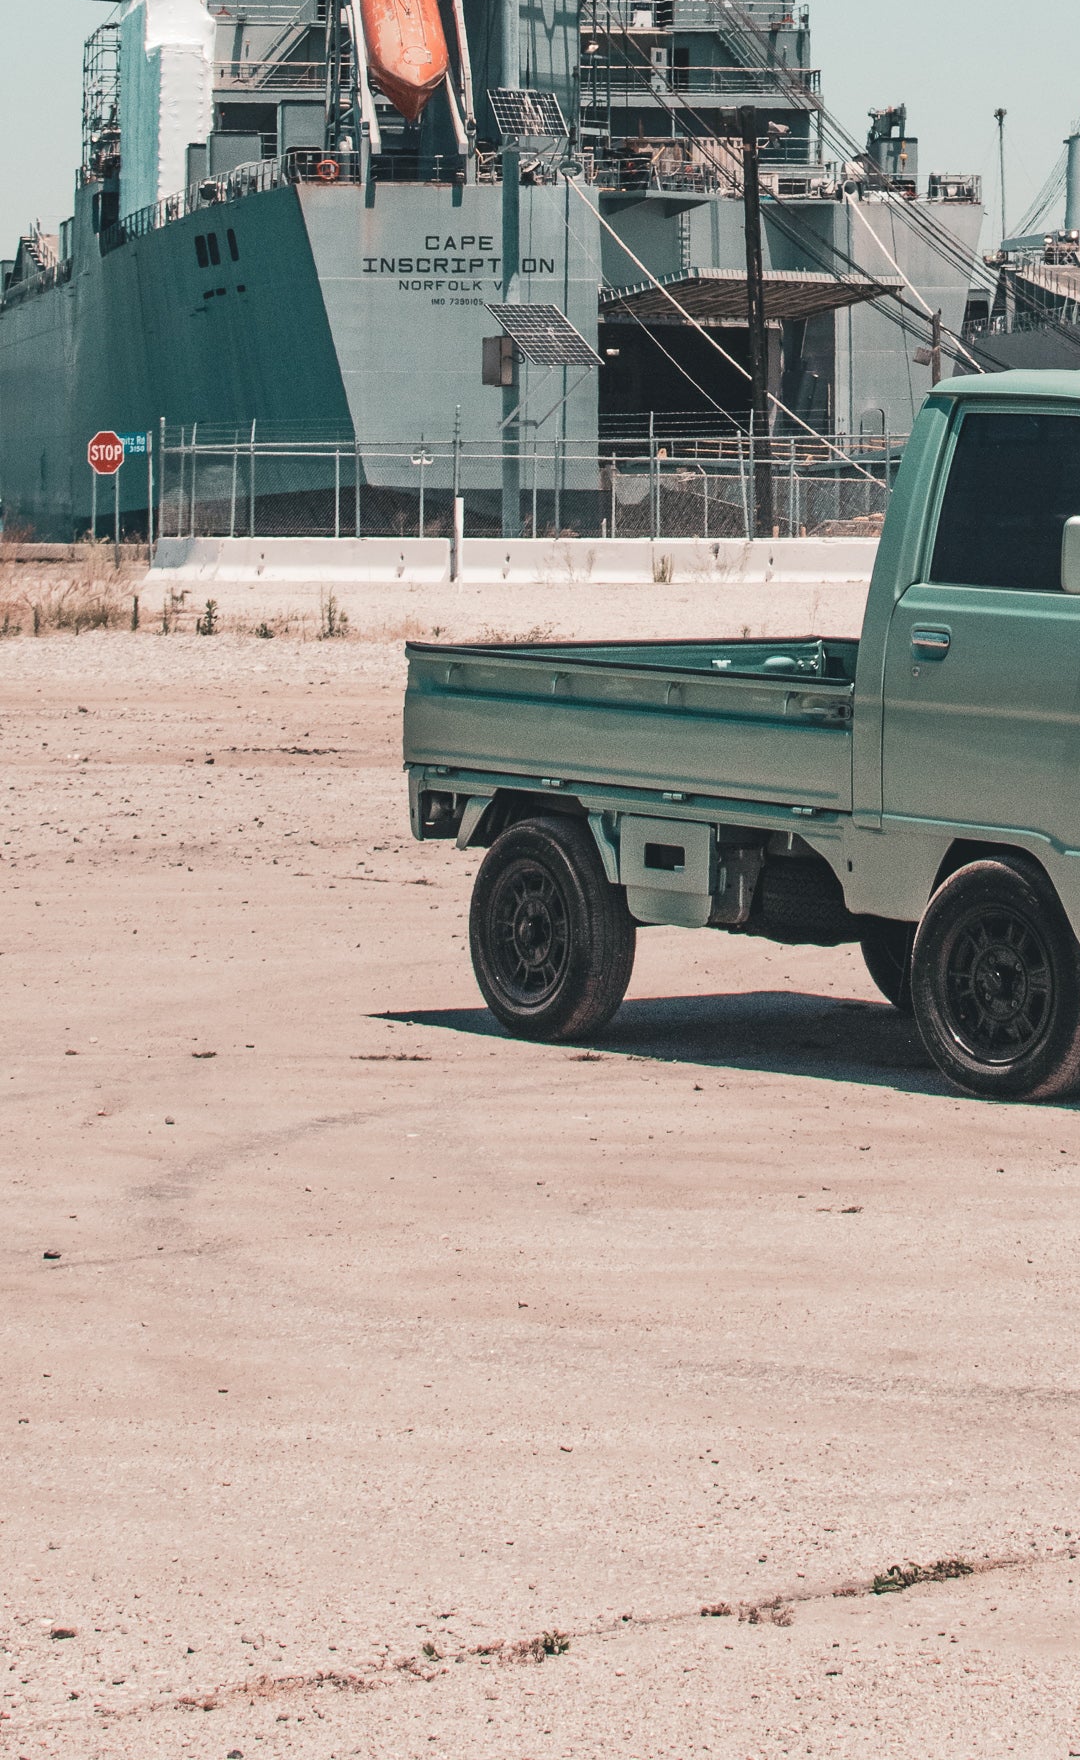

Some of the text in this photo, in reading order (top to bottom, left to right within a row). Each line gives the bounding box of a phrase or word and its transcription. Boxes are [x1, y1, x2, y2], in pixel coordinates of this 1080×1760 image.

[425, 236, 494, 250] CAPE
[362, 258, 555, 273] INSCRIPTON
[398, 280, 482, 291] NORFOLK
[137, 436, 145, 445] Rd
[91, 445, 122, 460] STOP
